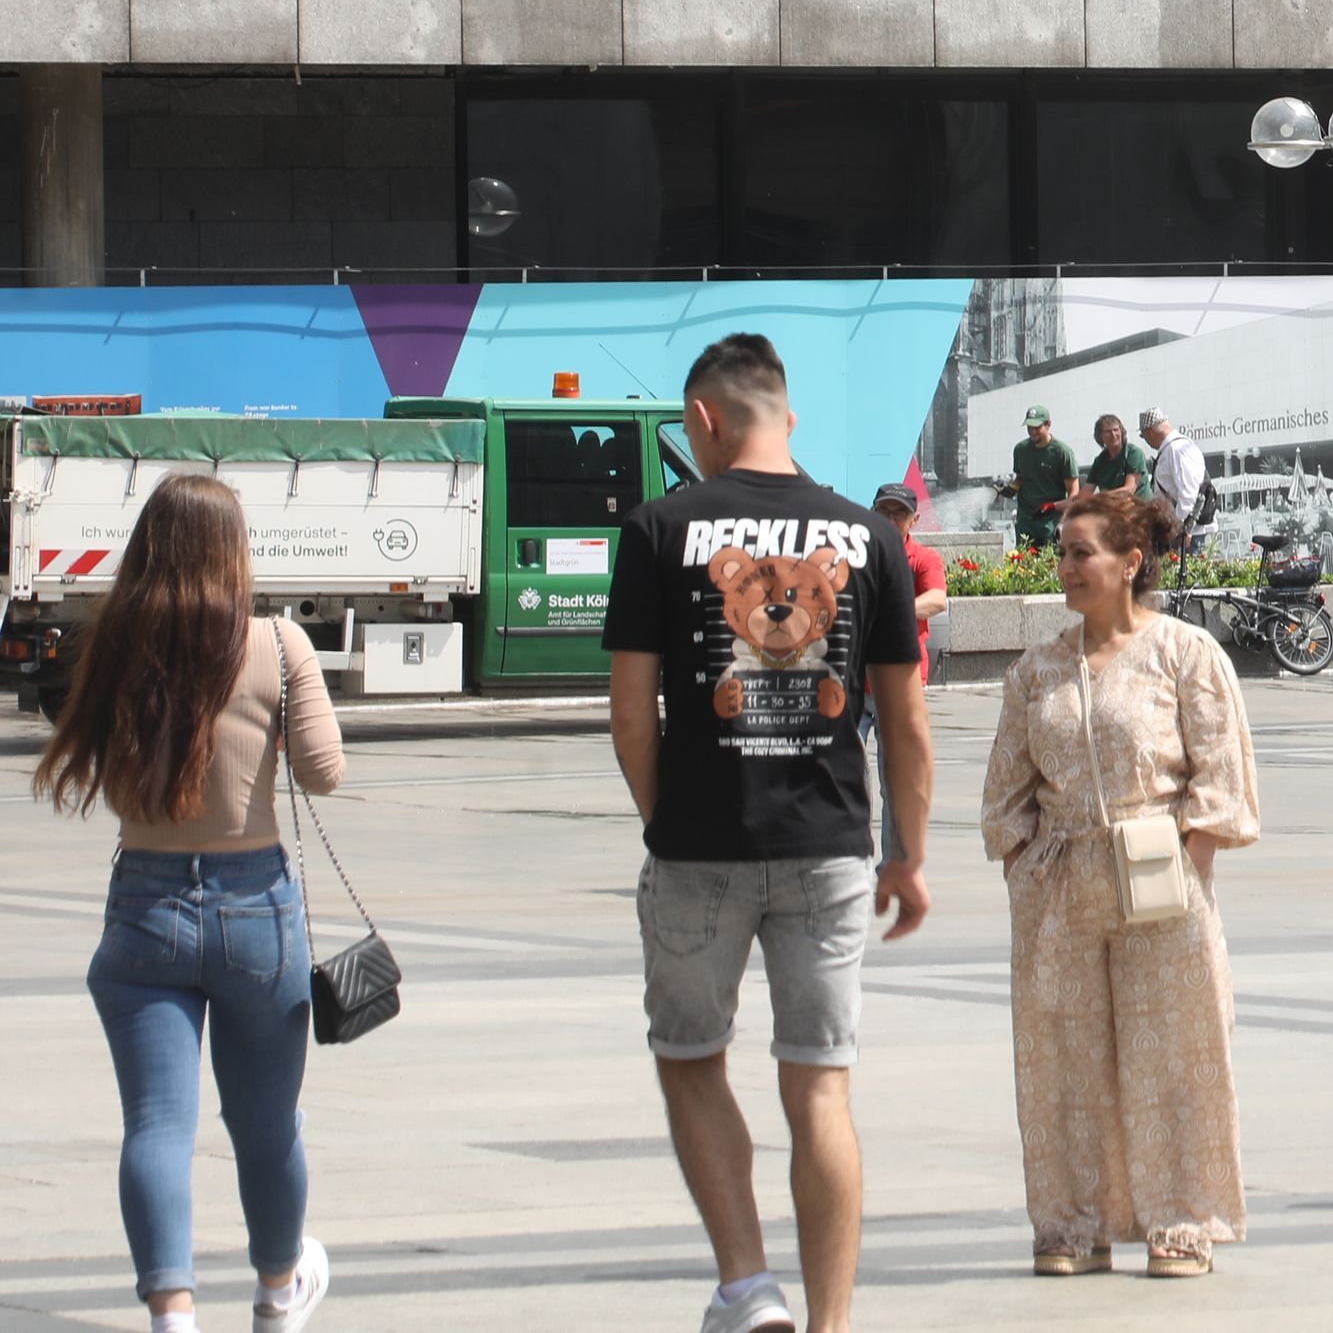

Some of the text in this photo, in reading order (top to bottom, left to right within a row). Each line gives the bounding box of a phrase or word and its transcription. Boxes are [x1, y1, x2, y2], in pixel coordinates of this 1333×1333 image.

[81, 526, 101, 538] Ich
[105, 529, 131, 538] wur
[260, 526, 337, 542] umgerüstet
[682, 518, 871, 569] RECKLESS
[268, 545, 289, 557] die
[293, 544, 348, 557] Umwelt!
[548, 594, 584, 607] Stadt
[691, 591, 701, 602] 70
[693, 632, 704, 642] 60
[696, 673, 706, 684] 50
[747, 715, 757, 724] LA
[759, 715, 786, 724] POLICE
[741, 746, 753, 756] THE
